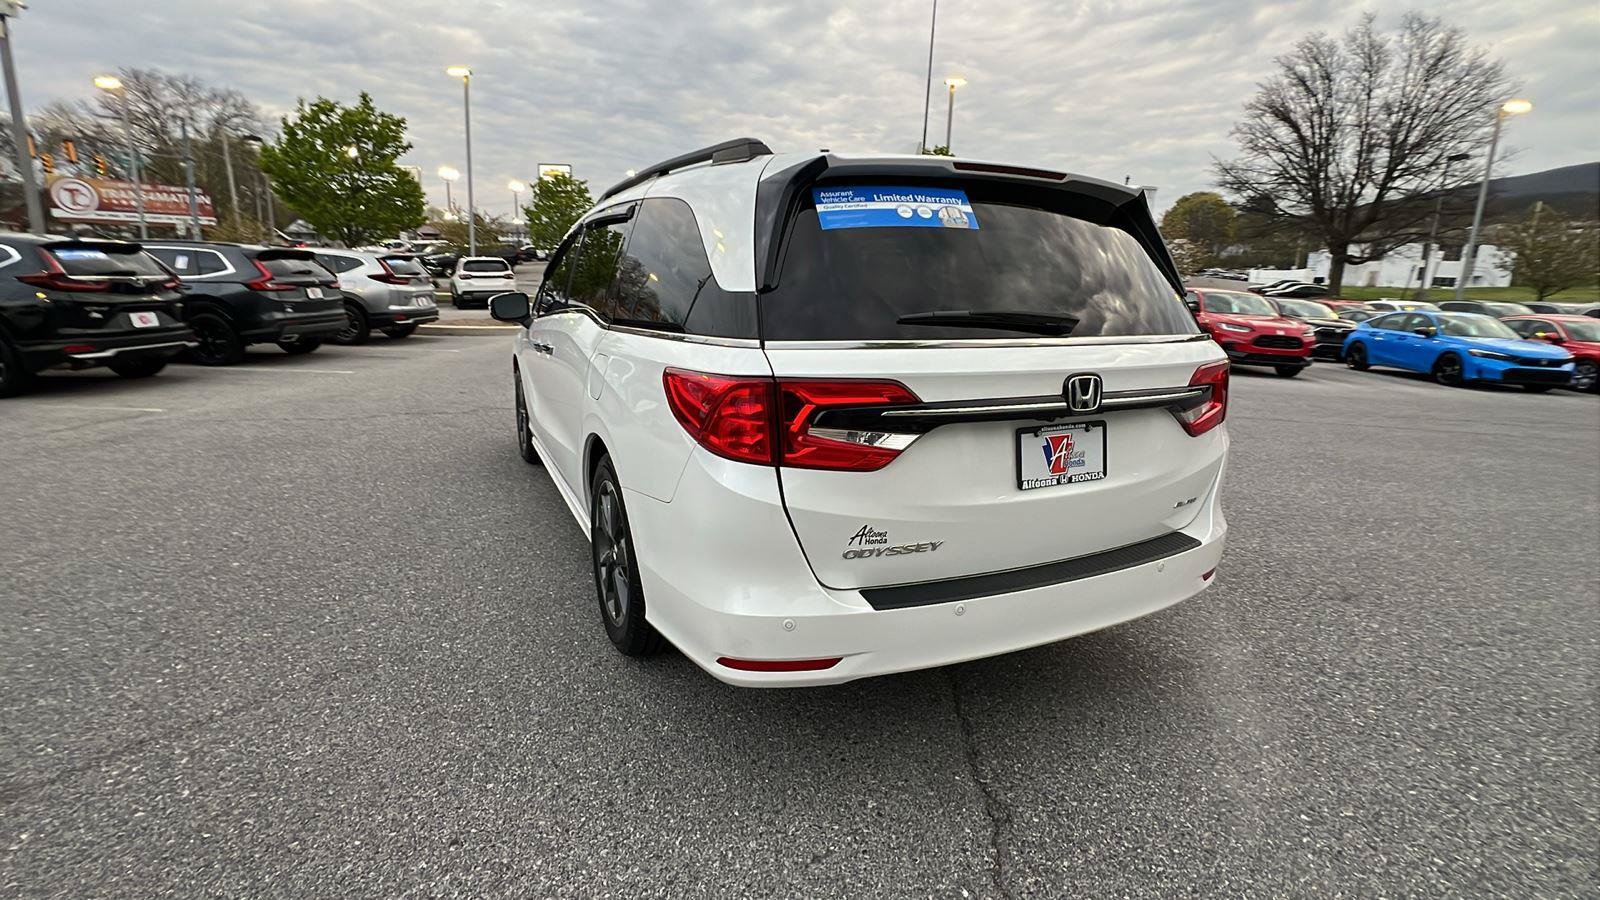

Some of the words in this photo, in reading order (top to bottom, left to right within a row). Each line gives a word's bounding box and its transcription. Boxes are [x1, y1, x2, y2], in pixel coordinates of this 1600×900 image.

[820, 190, 853, 198] Assurant
[873, 194, 913, 202] Limited
[914, 194, 962, 205] Warranty
[1022, 477, 1058, 490] Altoona
[1071, 471, 1105, 482] HONDA
[848, 524, 888, 546] Altoona
[864, 537, 888, 545] Honda
[842, 540, 944, 560] ODYSSEY
